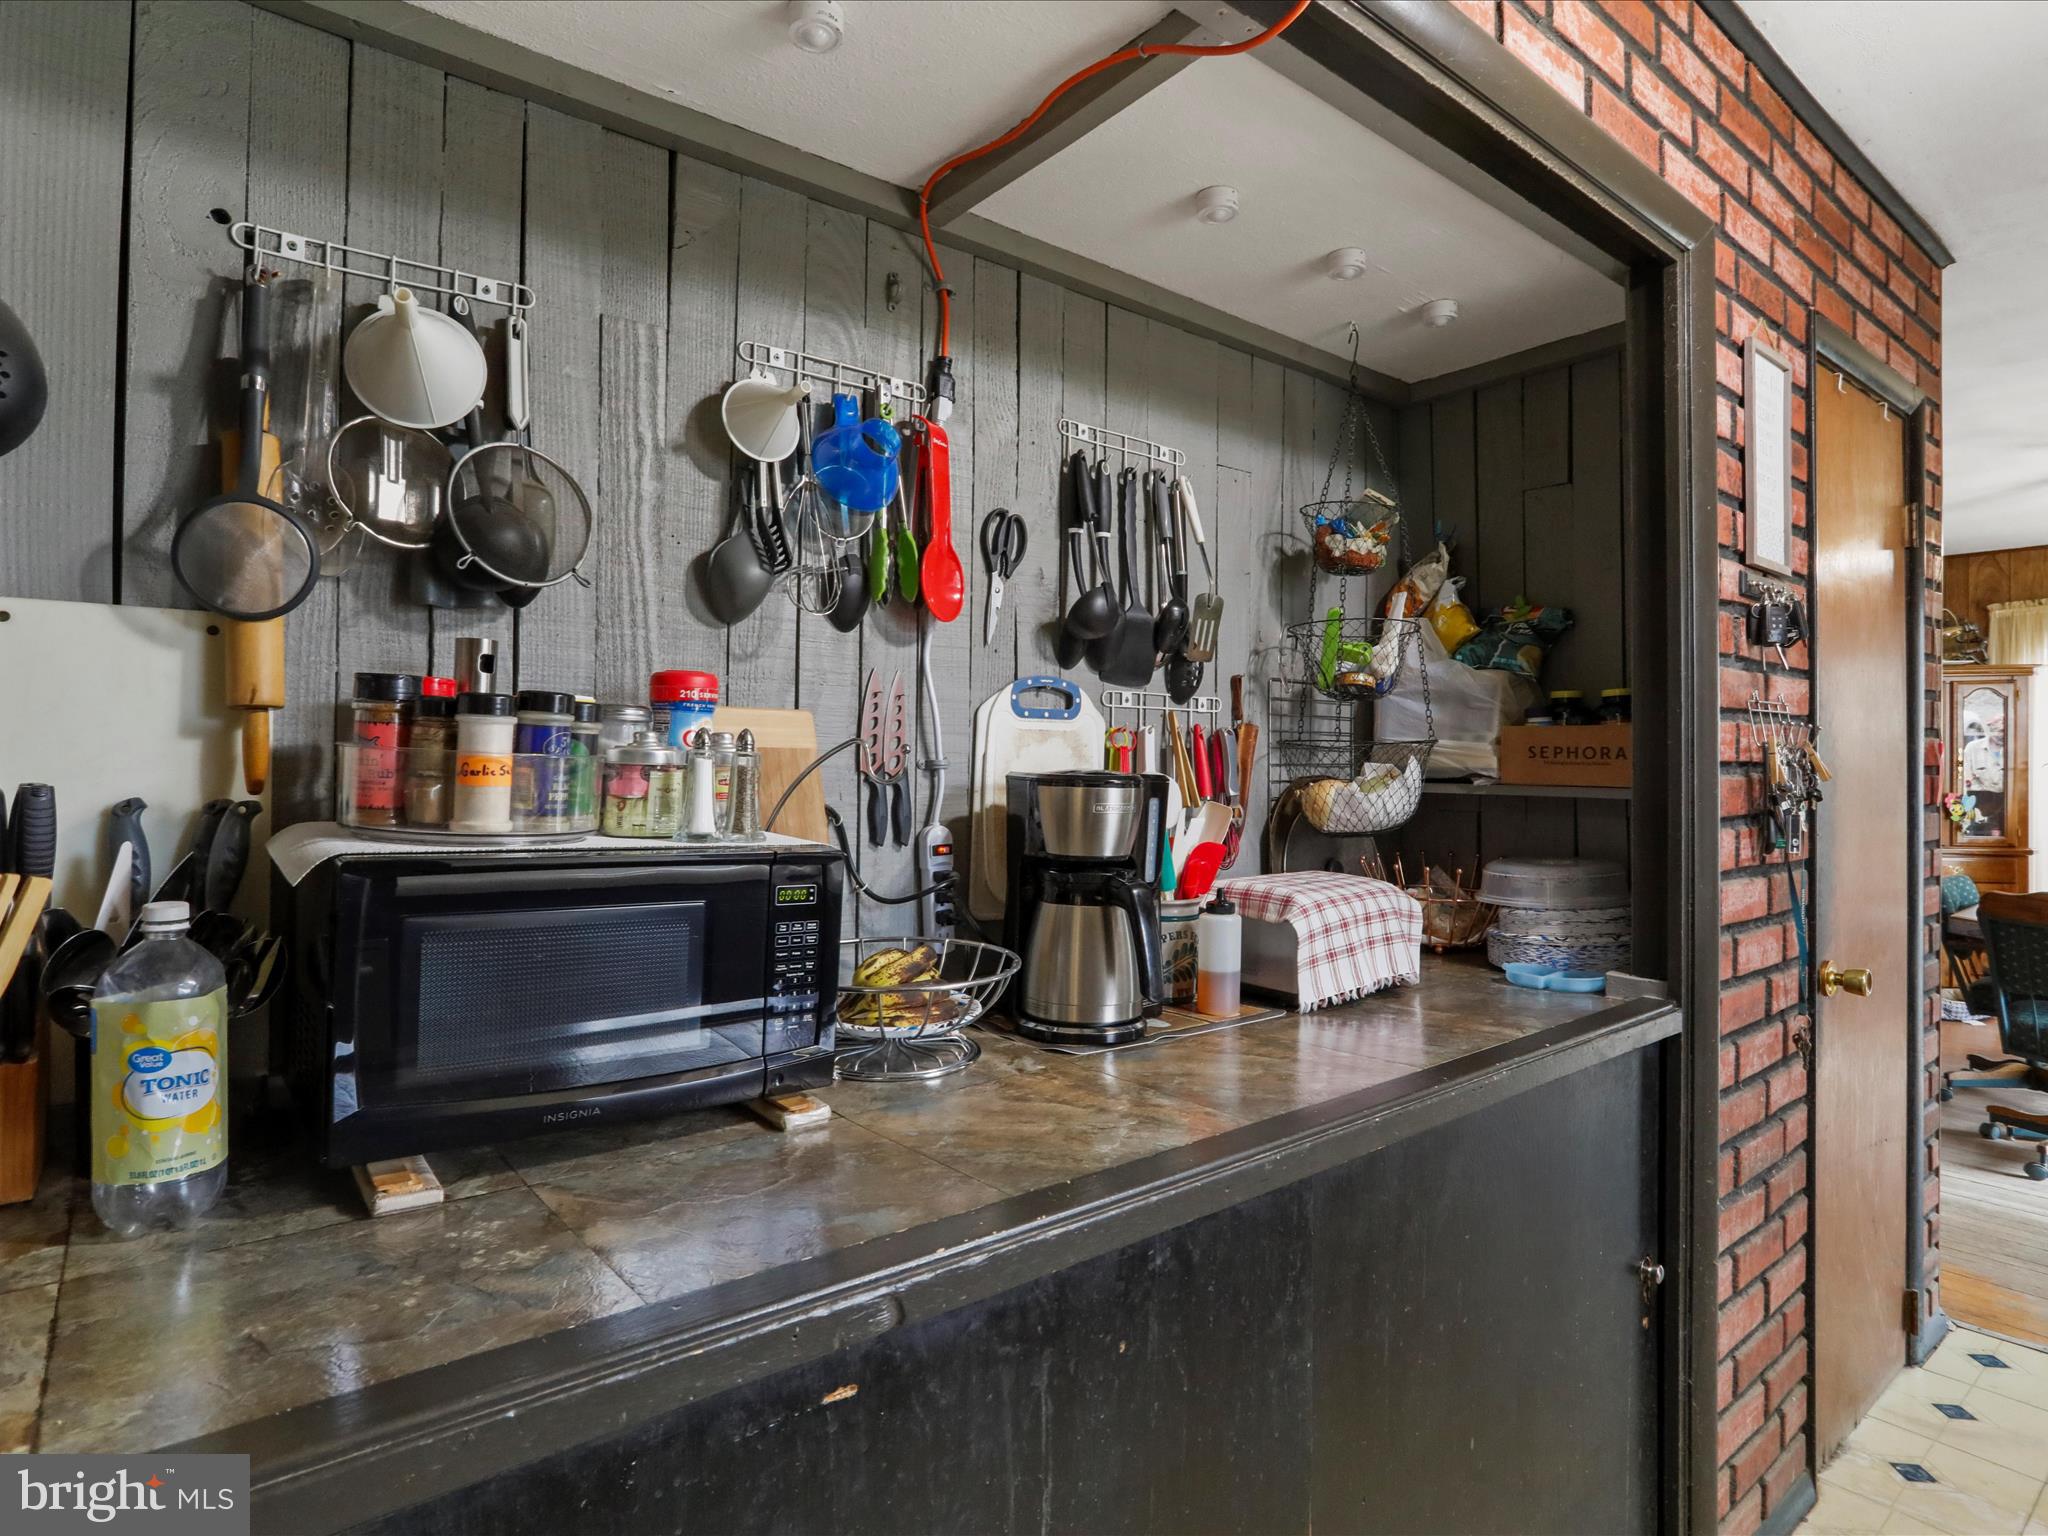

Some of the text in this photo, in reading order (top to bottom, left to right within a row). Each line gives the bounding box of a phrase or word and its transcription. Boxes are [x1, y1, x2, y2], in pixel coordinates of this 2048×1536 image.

[679, 688, 699, 699] 210
[1528, 745, 1628, 760] SEPHORA
[460, 762, 497, 777] Garlic
[132, 1053, 164, 1063] Great
[140, 1069, 210, 1096] TONIC
[161, 1088, 199, 1104] WATER
[543, 1107, 601, 1123] INSIGNIA
